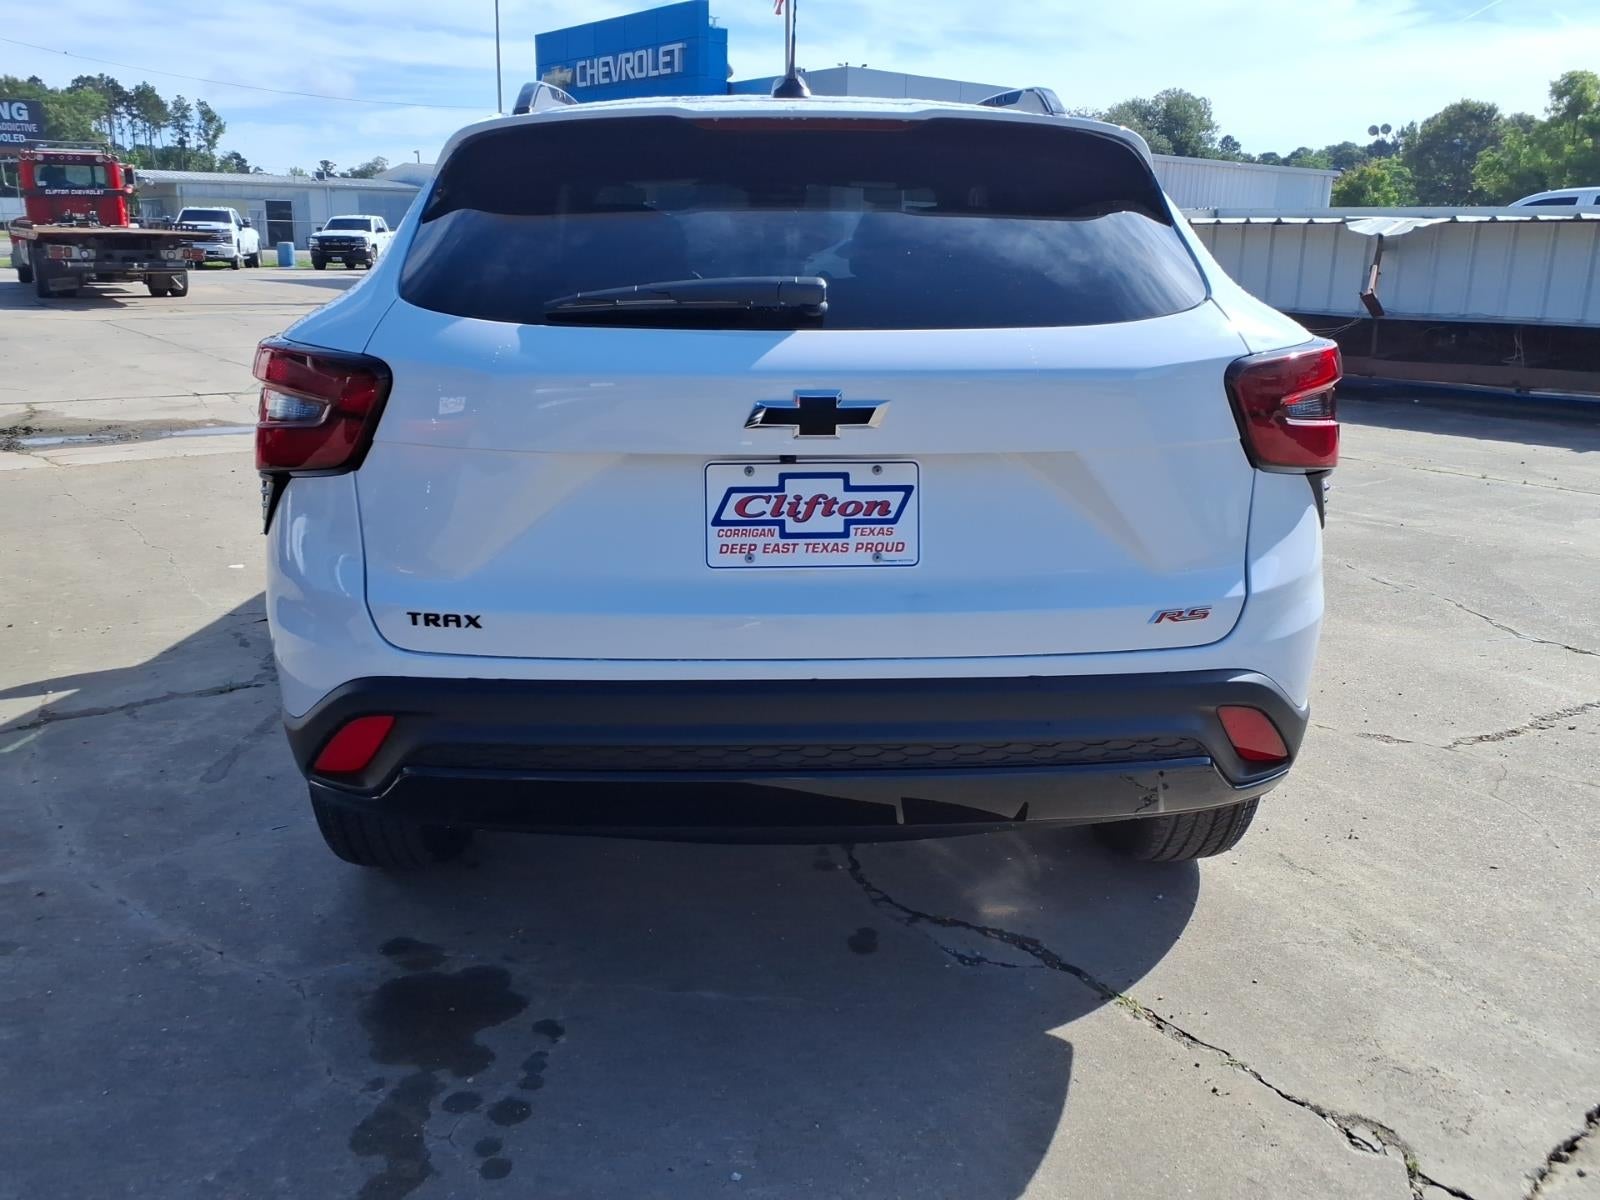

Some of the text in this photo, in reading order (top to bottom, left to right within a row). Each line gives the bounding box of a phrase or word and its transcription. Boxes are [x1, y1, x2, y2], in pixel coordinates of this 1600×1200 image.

[576, 42, 686, 87] CHEVROLET
[0, 123, 38, 132] DDICTIVE
[0, 134, 25, 142] OLED
[734, 494, 891, 523] Clifton
[717, 527, 894, 538] CORRIGAN TEXAS
[719, 541, 905, 554] DEEP EAST TEXAS PROUD
[406, 611, 483, 629] TRAX
[1147, 605, 1212, 624] RS
